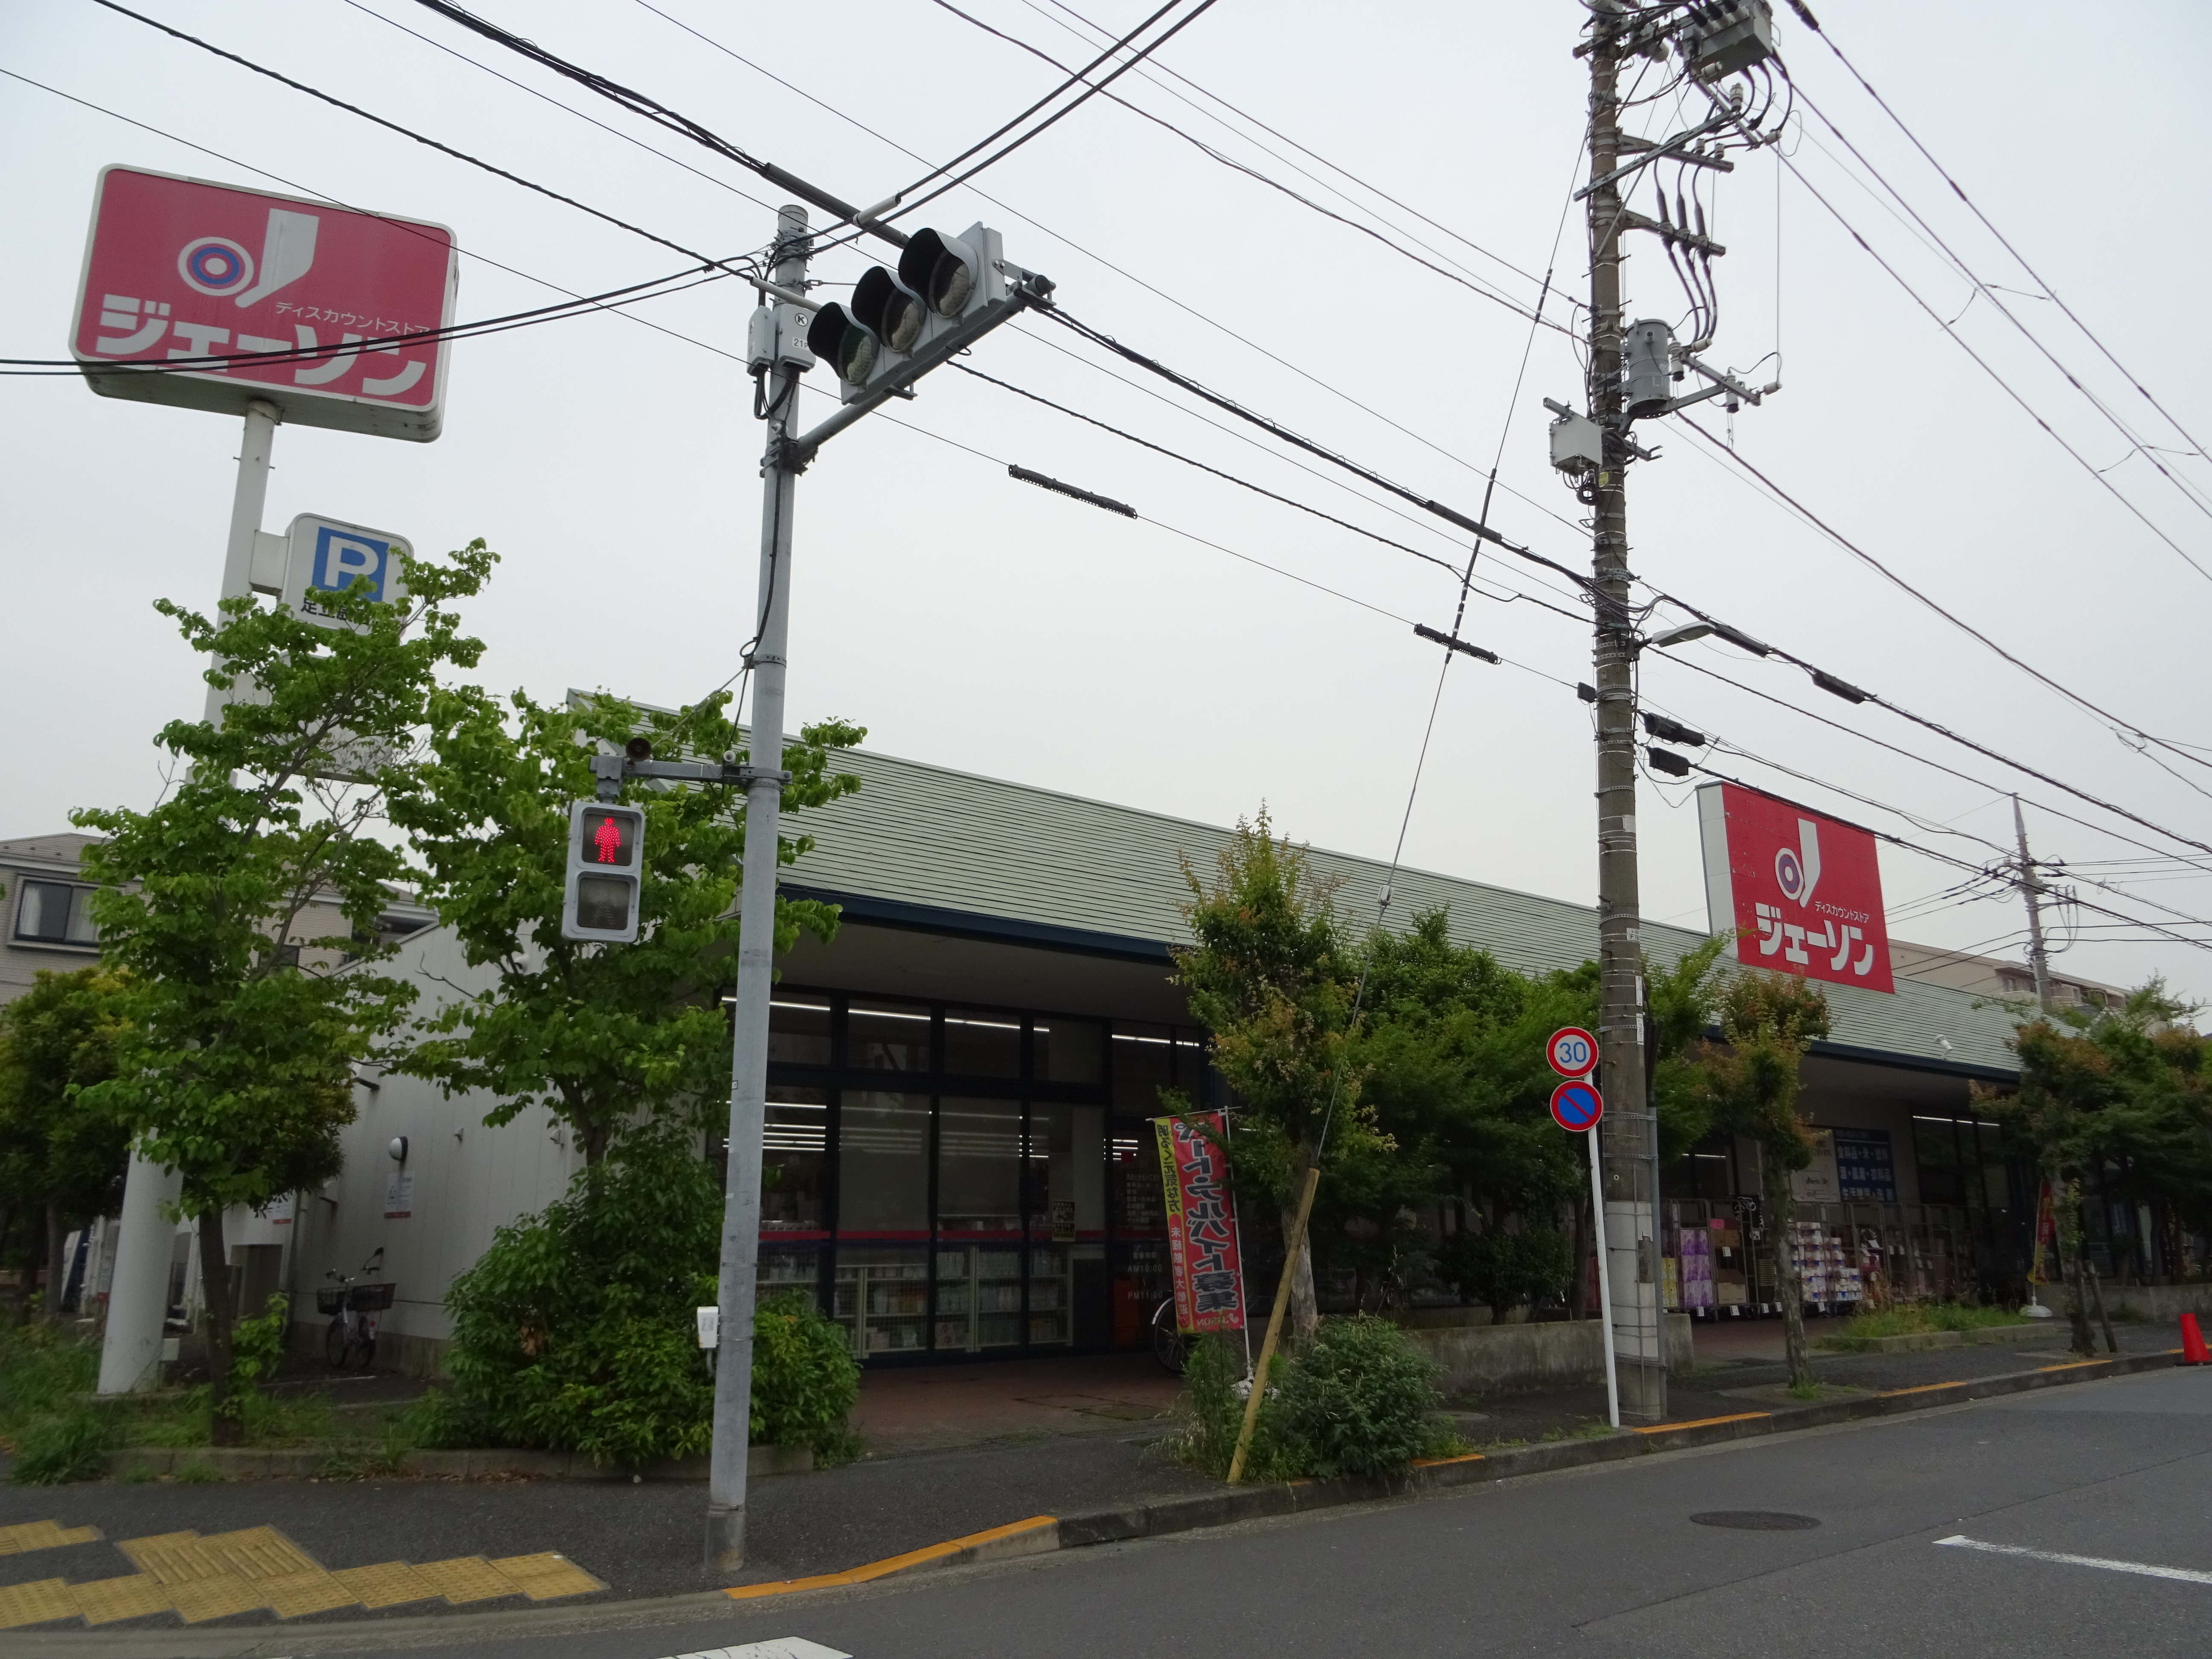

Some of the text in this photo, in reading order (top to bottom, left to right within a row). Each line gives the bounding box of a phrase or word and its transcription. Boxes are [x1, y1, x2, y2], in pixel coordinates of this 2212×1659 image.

[276, 301, 431, 335] ディスカウントストア
[96, 294, 427, 396] ジェーソン
[1814, 901, 1869, 923] ディスカウントストア
[1755, 902, 1873, 976] ジェーソン
[1560, 1042, 1586, 1063] 30
[1127, 1264, 1162, 1272] AM10:00
